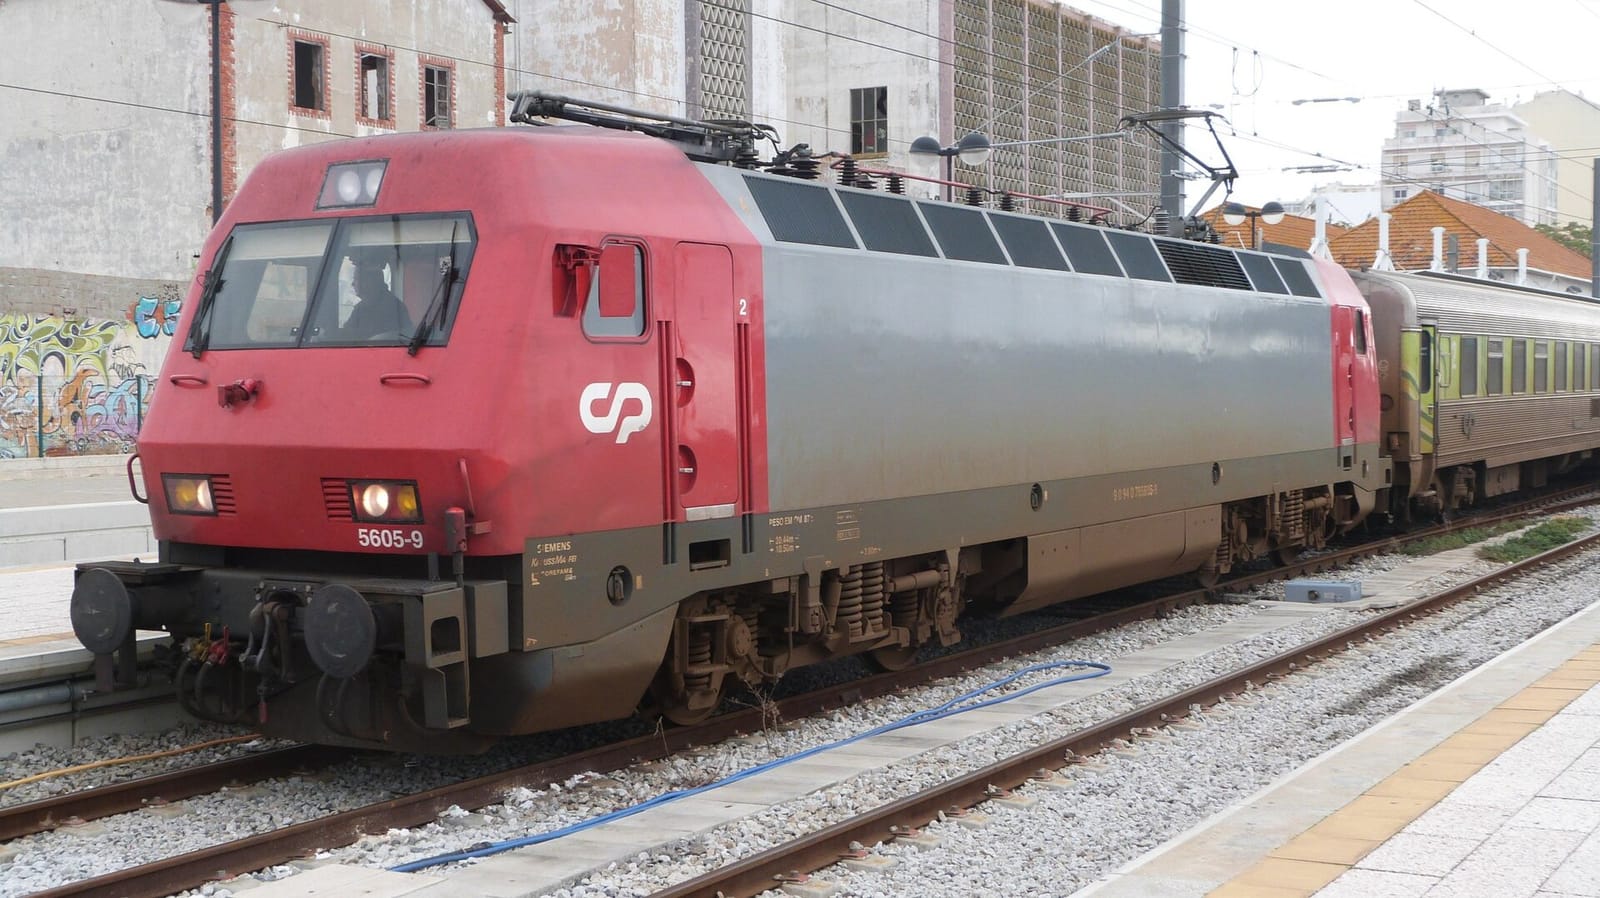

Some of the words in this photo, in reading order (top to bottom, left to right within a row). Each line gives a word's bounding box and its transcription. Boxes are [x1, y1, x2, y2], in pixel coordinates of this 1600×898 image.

[739, 299, 747, 315] 2
[579, 382, 653, 444] CP
[358, 528, 424, 549] 5605-9
